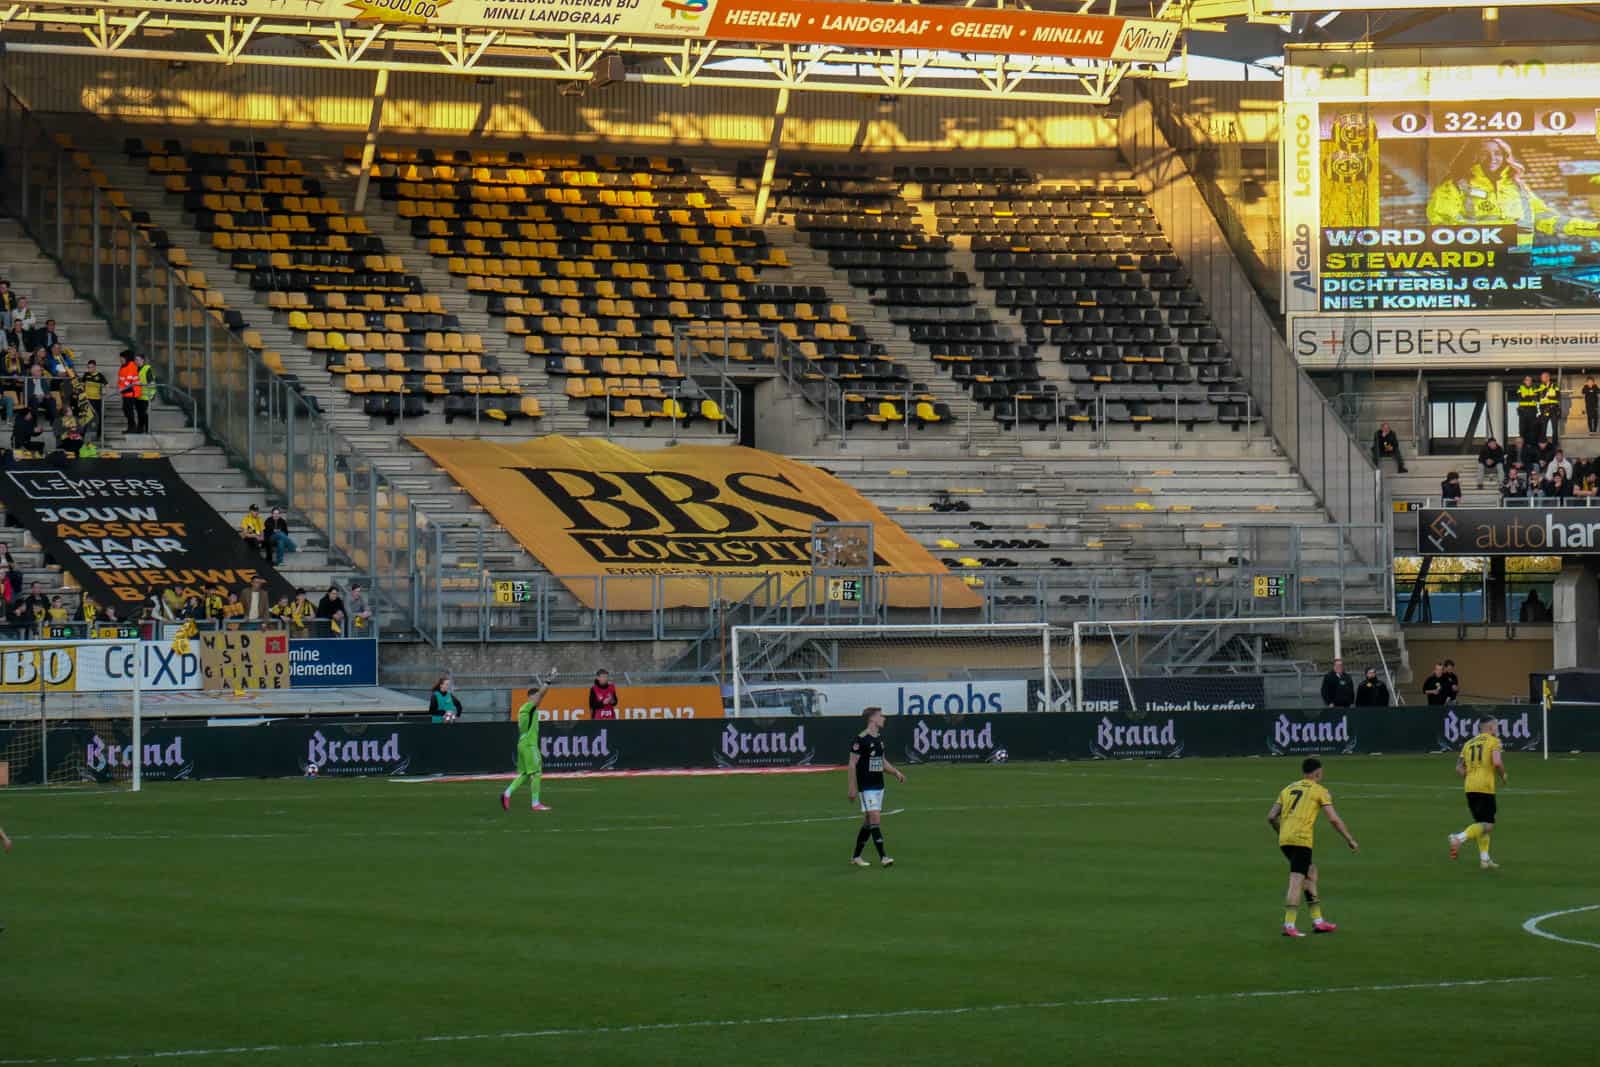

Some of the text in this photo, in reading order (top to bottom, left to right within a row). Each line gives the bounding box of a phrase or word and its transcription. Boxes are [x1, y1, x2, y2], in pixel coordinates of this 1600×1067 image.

[364, 0, 436, 17] 500,00
[483, 8, 622, 25] MINLI LANDGRAAF
[725, 10, 1104, 45] HEERLEN LANDGRAAF GELEEN MINLI.NL
[1120, 26, 1173, 51] Minli
[1401, 112, 1566, 132] 0 32:40 0
[1294, 113, 1311, 197] Lenco
[1325, 228, 1503, 246] WORD OOK
[1290, 223, 1317, 294] Alecto
[1326, 251, 1495, 269] STEWARD!
[1323, 276, 1543, 292] DICHTERBIJ GA JE
[1324, 294, 1477, 309] NIET KOMEN.
[1491, 333, 1533, 348] Fysio
[1540, 332, 1600, 345] Revalid
[29, 479, 165, 491] LEMPERS
[502, 467, 842, 535] BBS
[35, 507, 158, 522] JOUW
[56, 523, 189, 537] ASSIST
[65, 538, 189, 553] NAAR
[587, 537, 814, 563] LOGISTI
[80, 554, 167, 569] EEN
[4, 649, 73, 686] BO
[105, 646, 202, 685] CelXp
[898, 683, 1003, 715] Jacobs
[613, 707, 695, 720] UREN?
[913, 719, 994, 754] Brand
[1097, 716, 1176, 750] Brand
[1275, 714, 1349, 747] Brand
[1444, 710, 1531, 742] Brnd
[308, 729, 402, 768] Brand
[540, 728, 609, 759] rand
[721, 724, 807, 759] Brand
[1470, 743, 1483, 762] 11
[1289, 789, 1303, 811] 7
